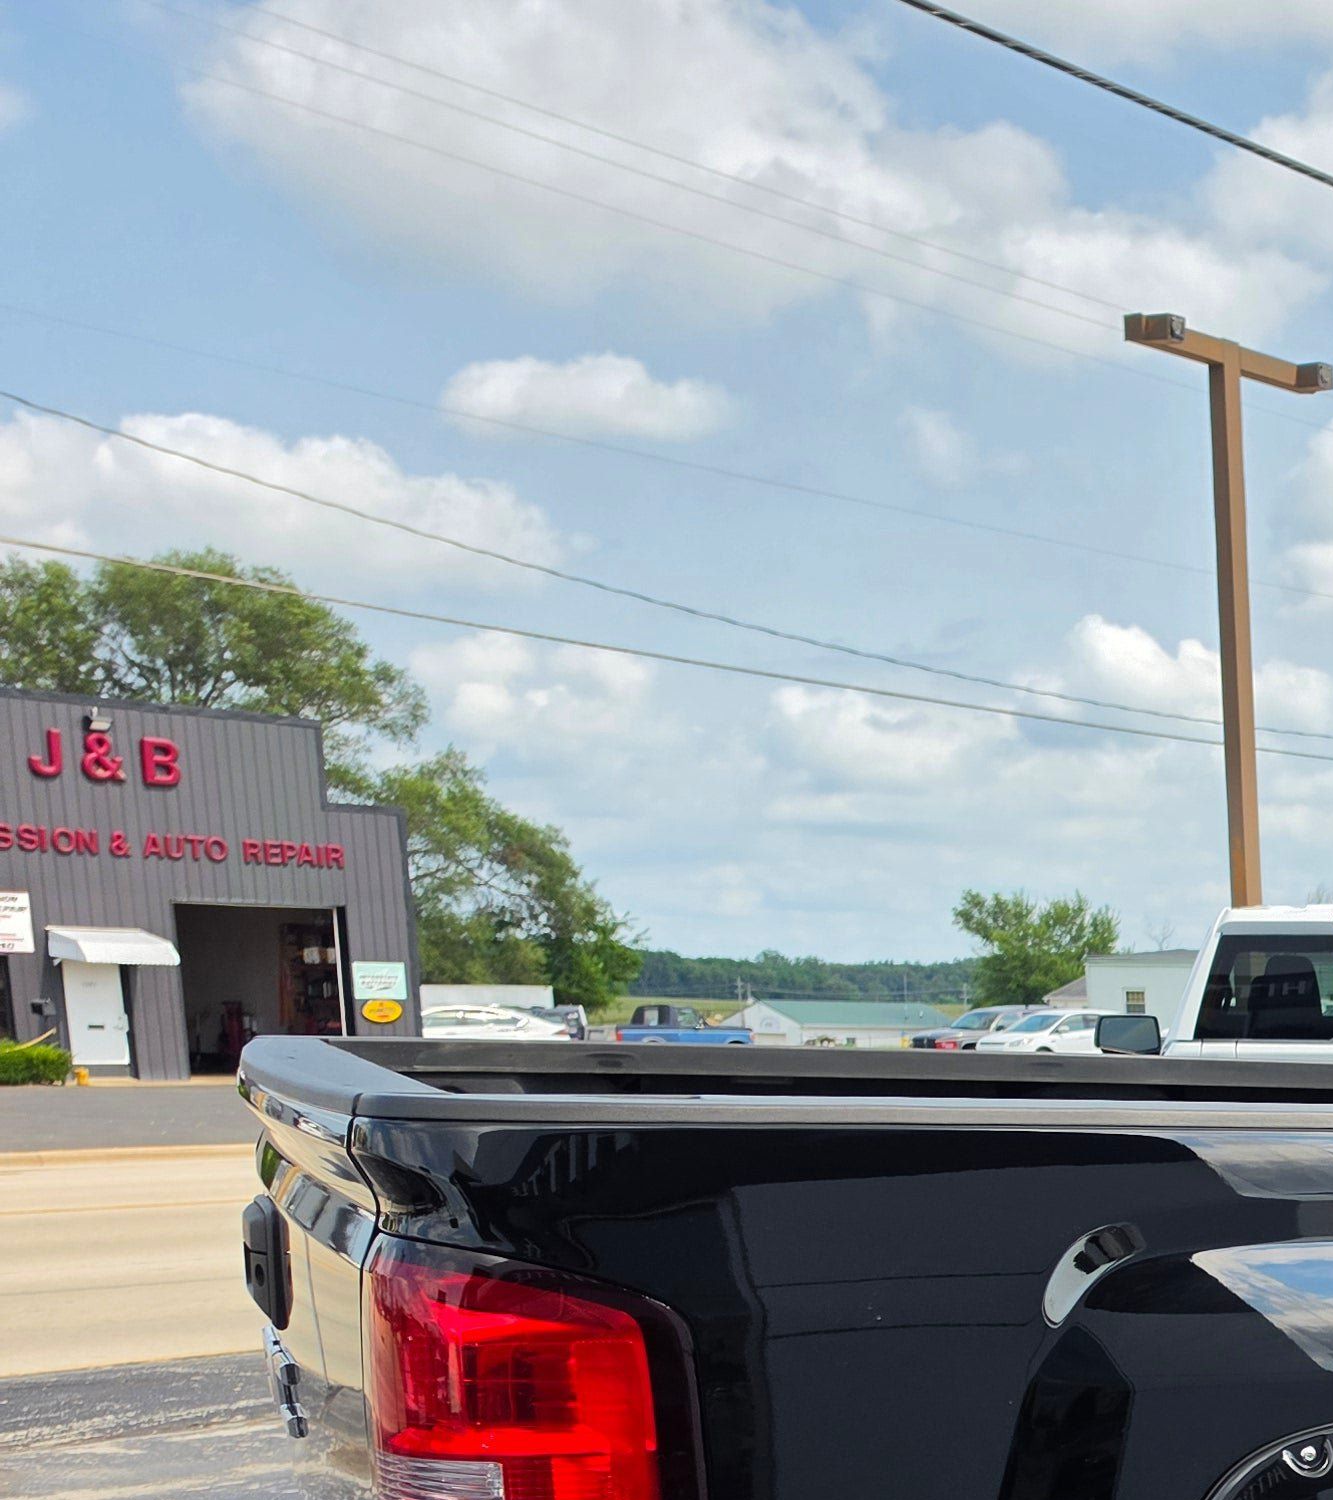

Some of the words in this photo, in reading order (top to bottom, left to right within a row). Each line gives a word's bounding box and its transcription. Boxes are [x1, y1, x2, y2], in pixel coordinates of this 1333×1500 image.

[109, 830, 131, 857] &
[143, 832, 229, 863] AUTO
[242, 837, 346, 870] REPAIR
